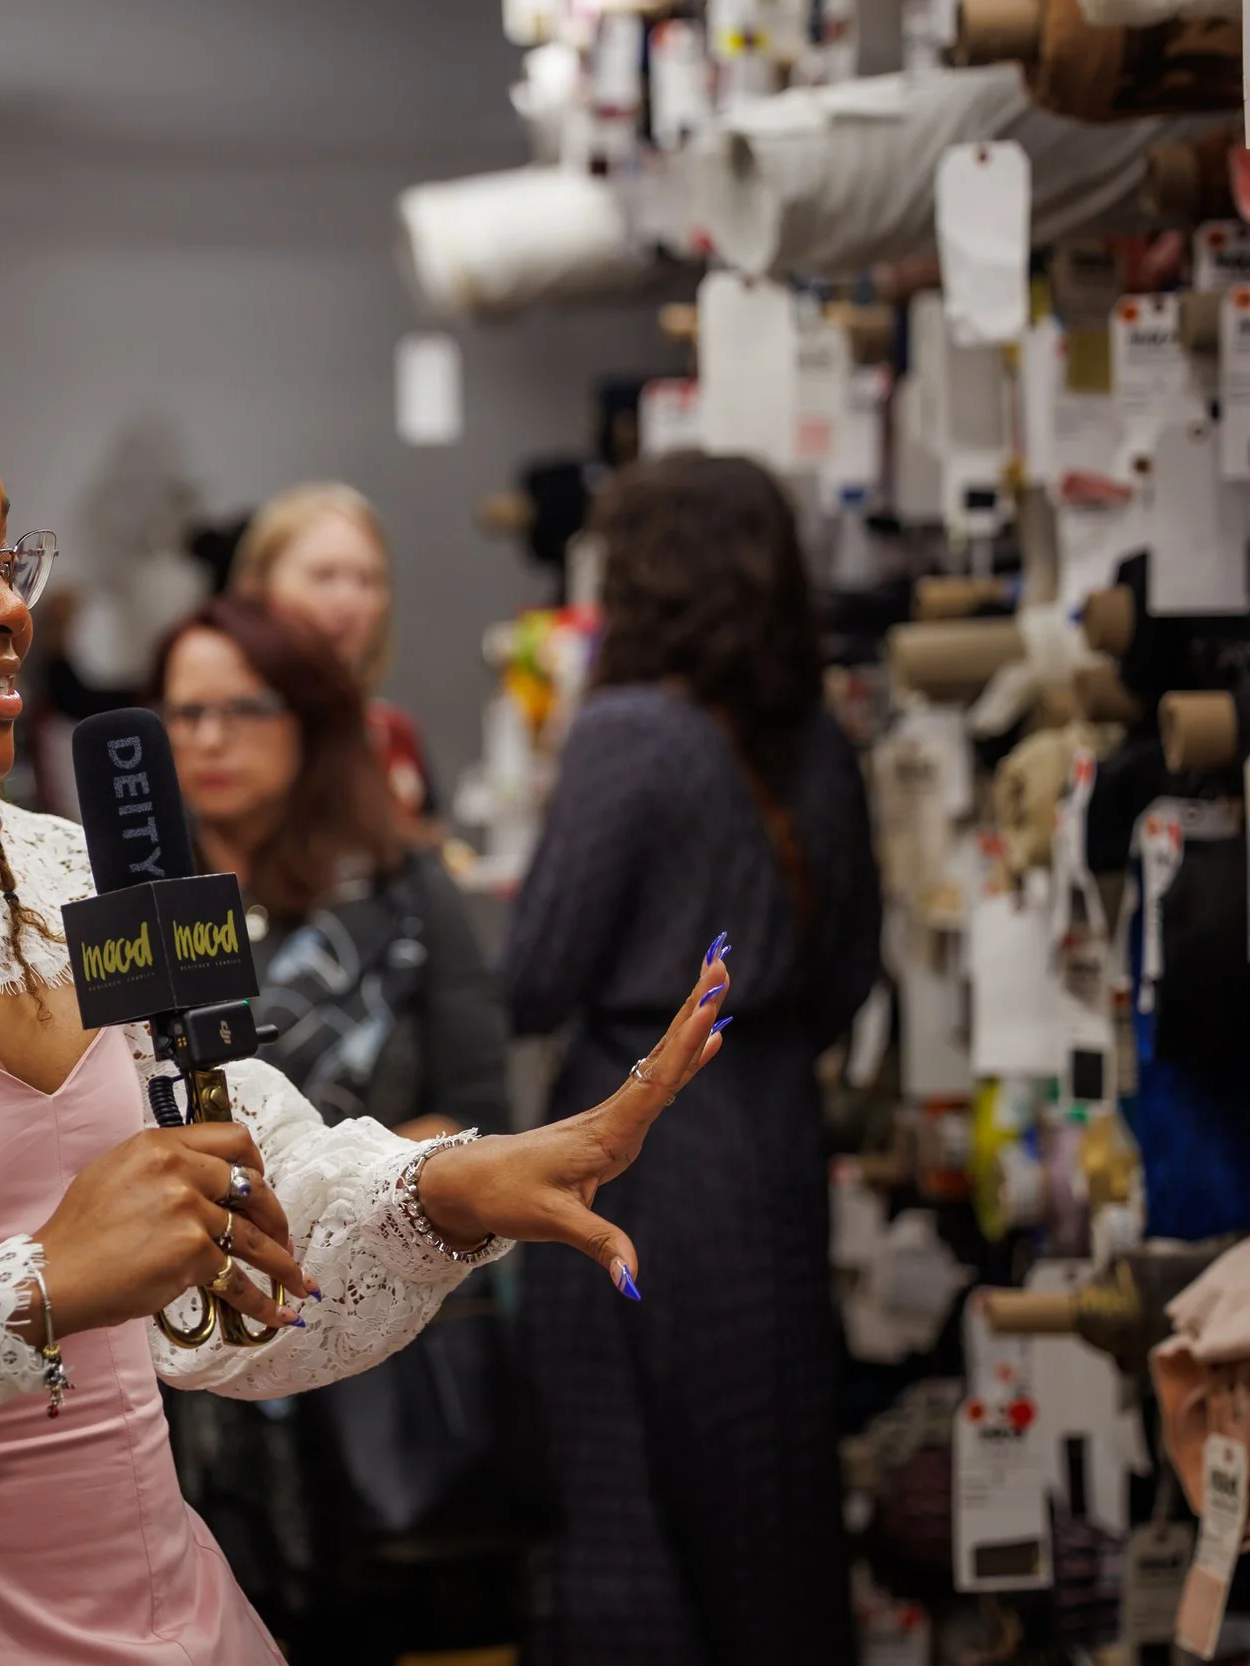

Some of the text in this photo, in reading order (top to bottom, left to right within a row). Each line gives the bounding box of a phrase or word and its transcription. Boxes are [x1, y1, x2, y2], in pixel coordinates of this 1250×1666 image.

[106, 735, 166, 878] DEITY
[81, 921, 153, 982] mood
[173, 909, 239, 962] mood
